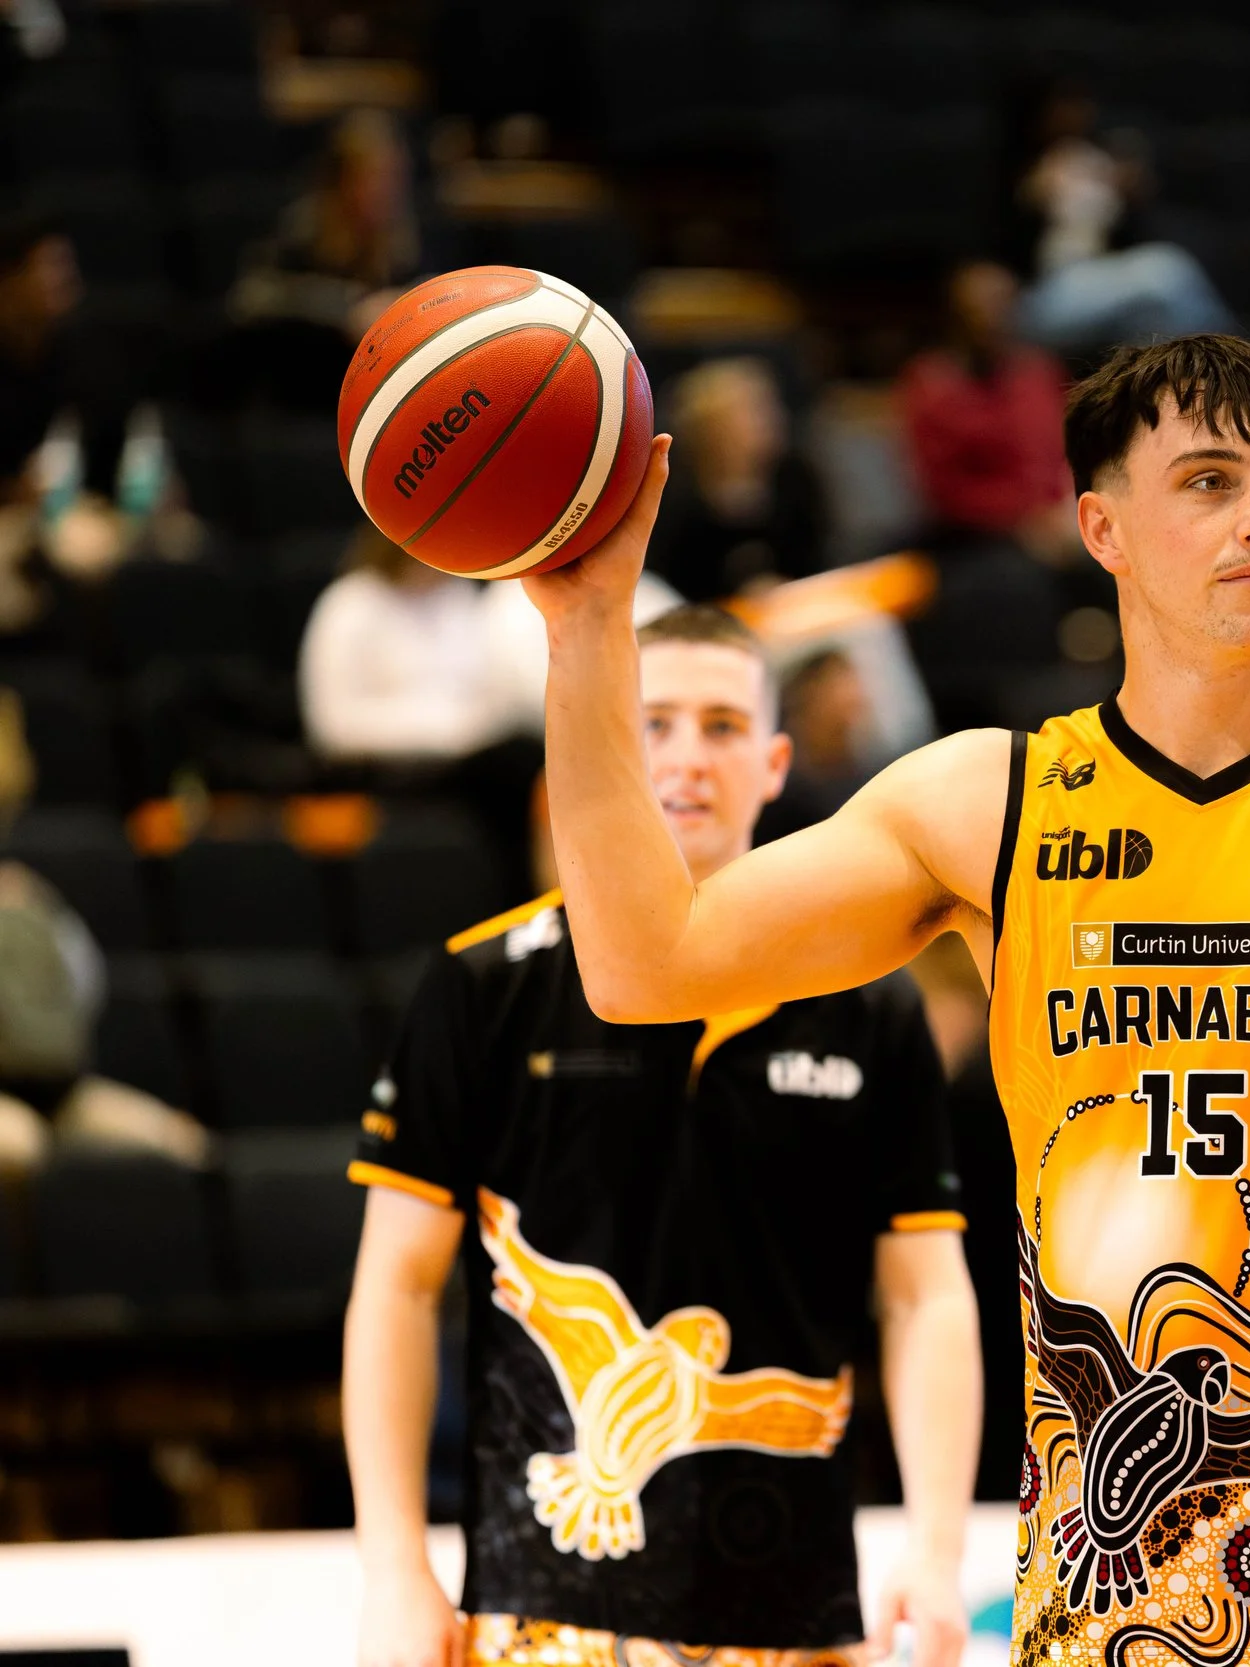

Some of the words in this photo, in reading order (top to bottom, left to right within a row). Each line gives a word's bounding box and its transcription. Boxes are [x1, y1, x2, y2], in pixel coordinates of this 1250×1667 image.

[393, 388, 491, 499] molten
[544, 502, 589, 549] BG4550
[1041, 828, 1071, 841] unisport
[1121, 934, 1186, 954] Curtin
[1137, 1069, 1249, 1180] 15
